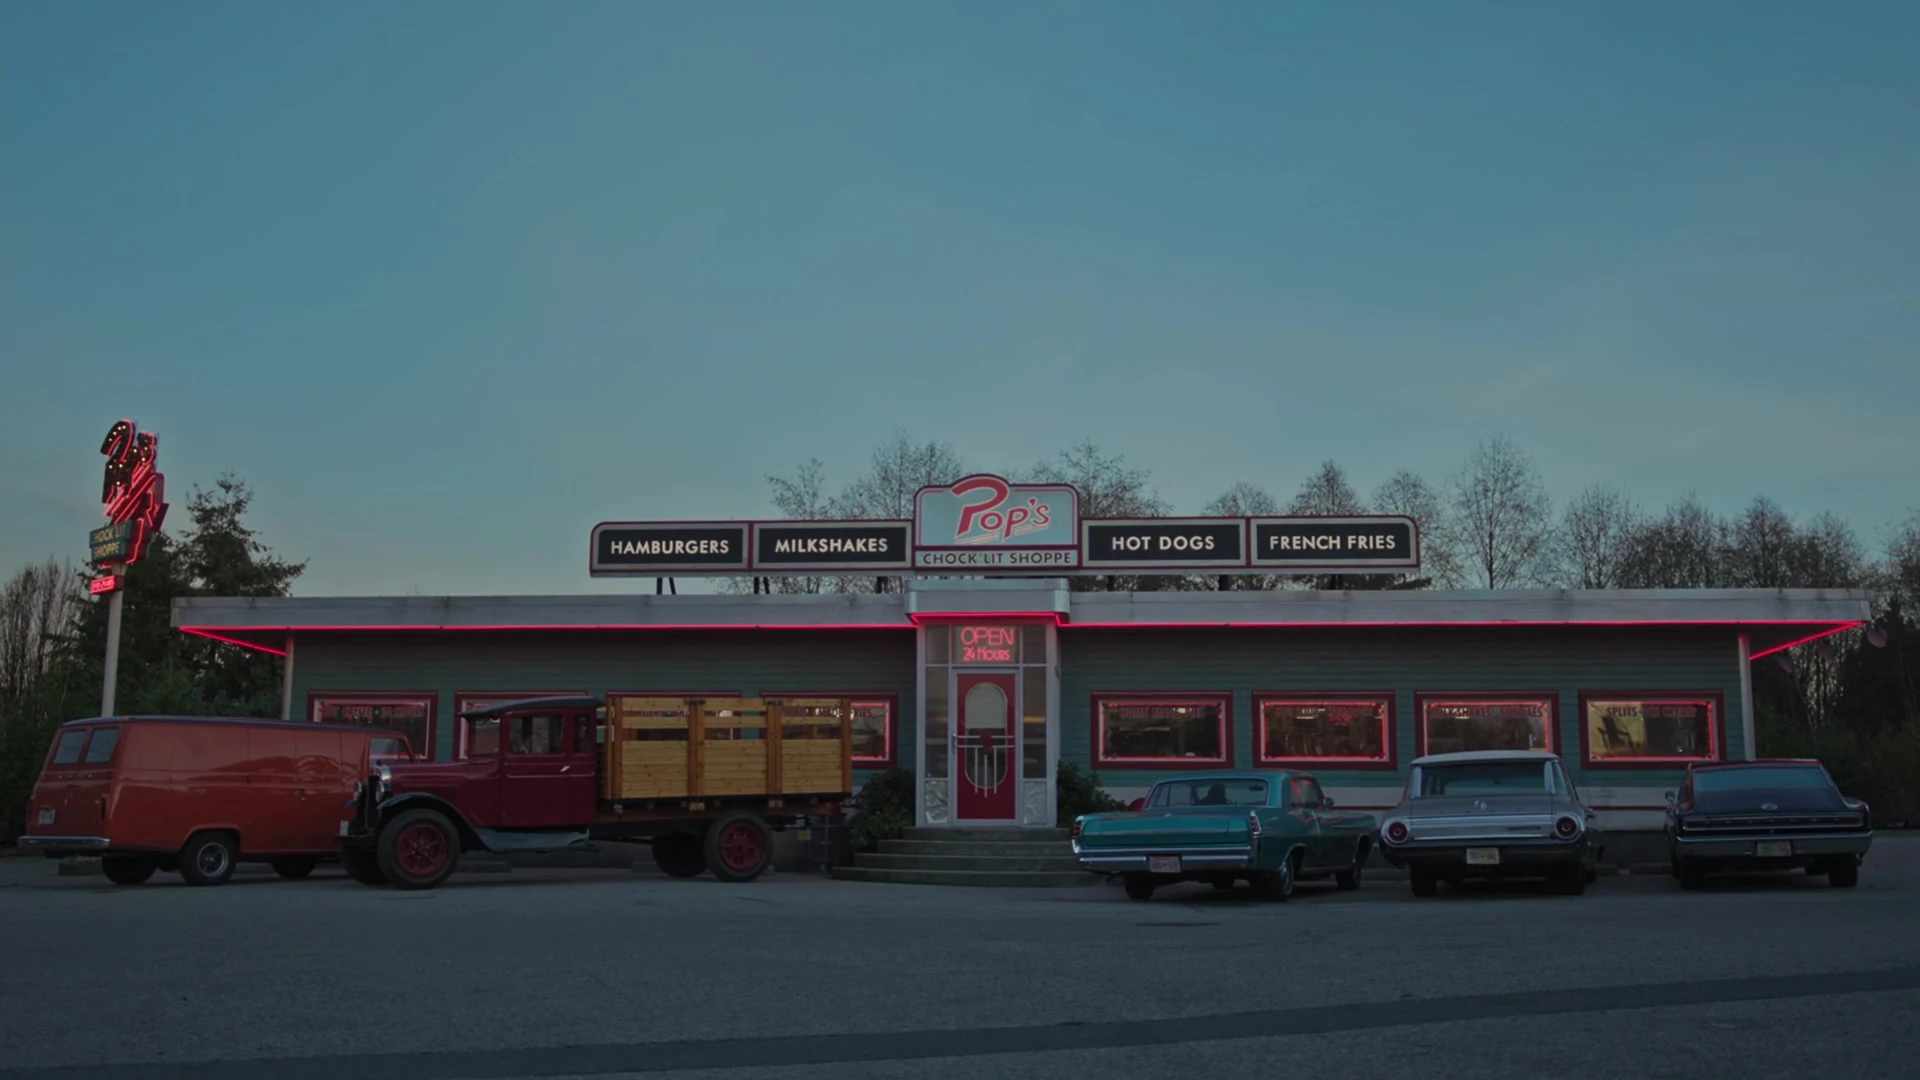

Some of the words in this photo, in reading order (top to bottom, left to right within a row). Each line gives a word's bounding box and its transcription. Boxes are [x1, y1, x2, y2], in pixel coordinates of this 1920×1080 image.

[950, 477, 1051, 541] Pop's
[610, 540, 729, 555] HAMBURGERS
[774, 537, 889, 553] MILKSHAKES
[1111, 536, 1152, 551] HOT
[1158, 536, 1216, 551] DOGS
[1269, 535, 1342, 550] FRENCH
[1346, 534, 1397, 550] FRIES
[1009, 552, 1071, 565] SHOPPE
[961, 626, 1015, 646] OPEN
[963, 646, 976, 661] 24
[1606, 707, 1637, 717] SPLITS
